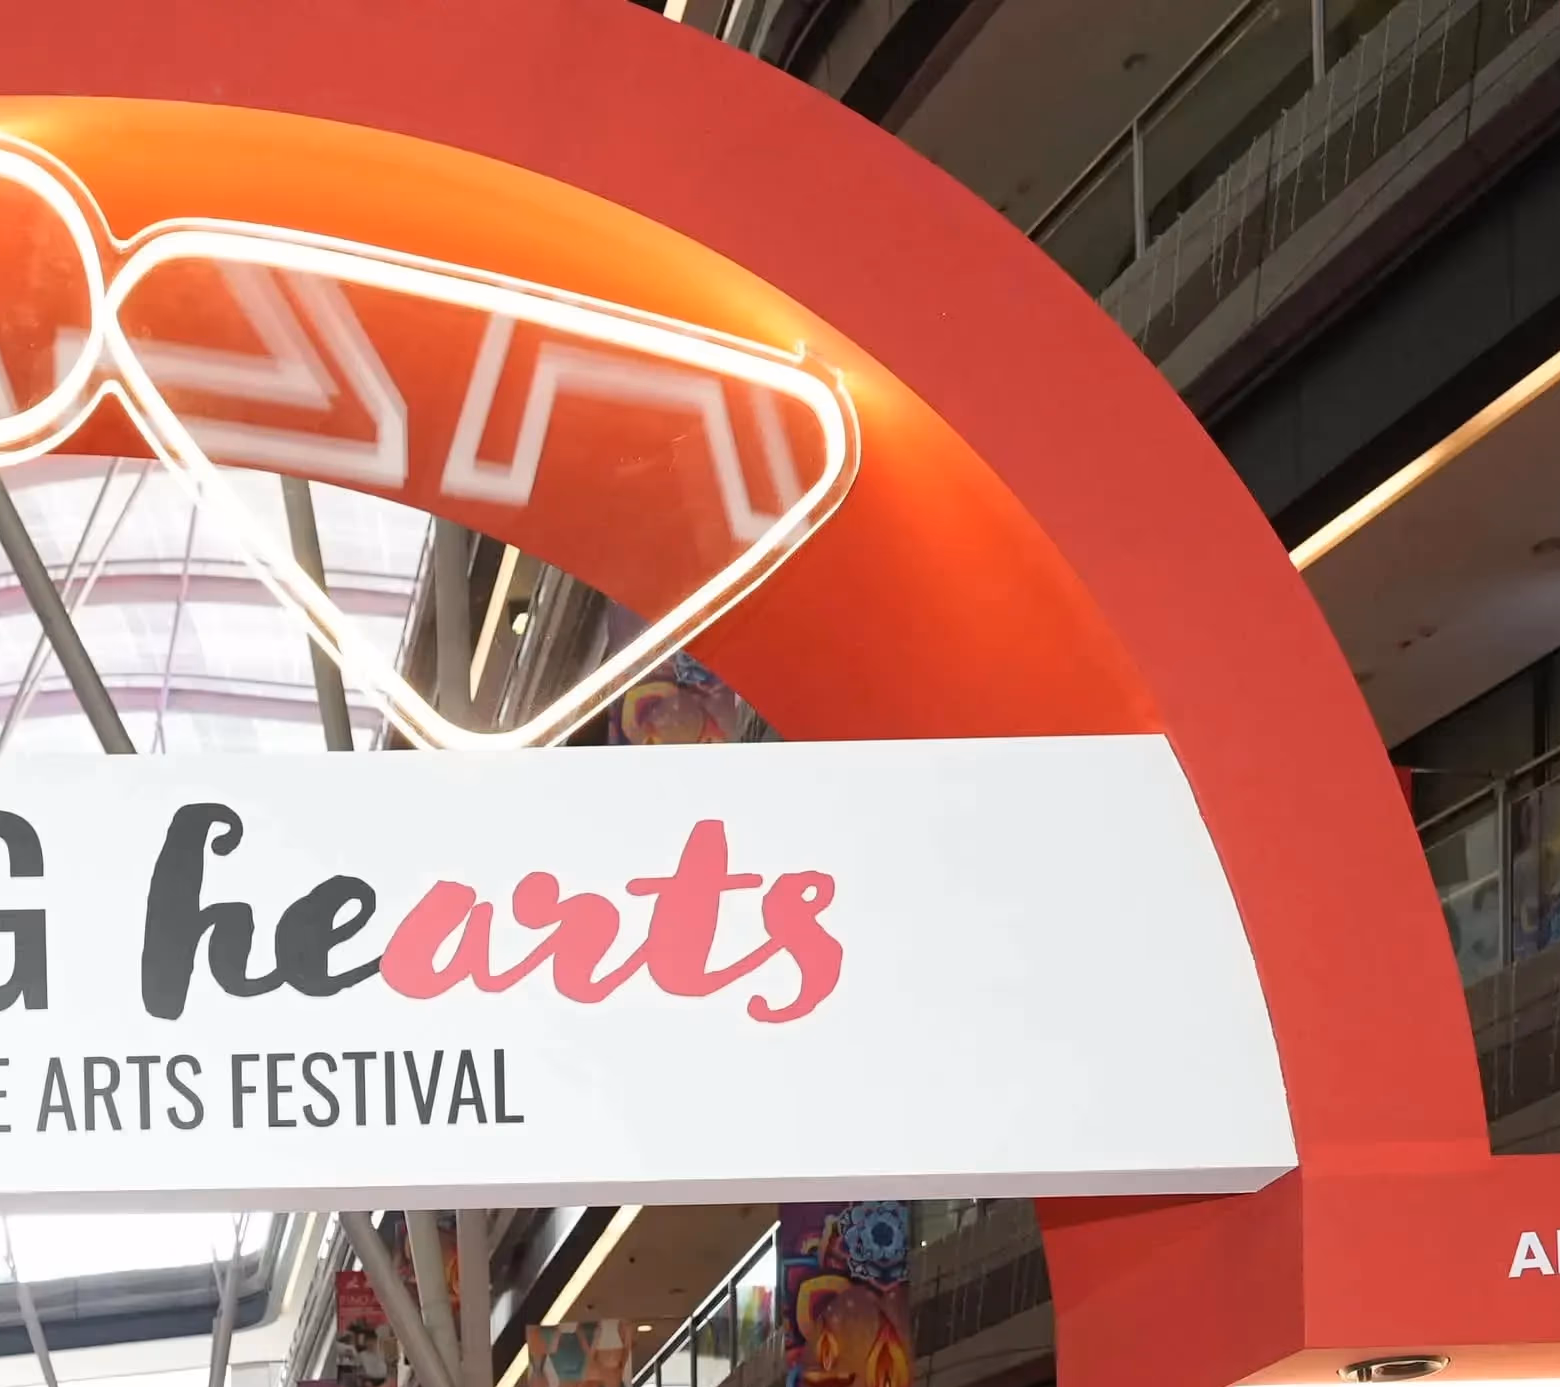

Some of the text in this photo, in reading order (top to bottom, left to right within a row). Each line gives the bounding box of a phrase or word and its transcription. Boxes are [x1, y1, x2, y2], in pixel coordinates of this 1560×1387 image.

[142, 802, 844, 1024] hearts
[37, 1053, 206, 1132] ARTS
[230, 1048, 525, 1129] FESTIVAL
